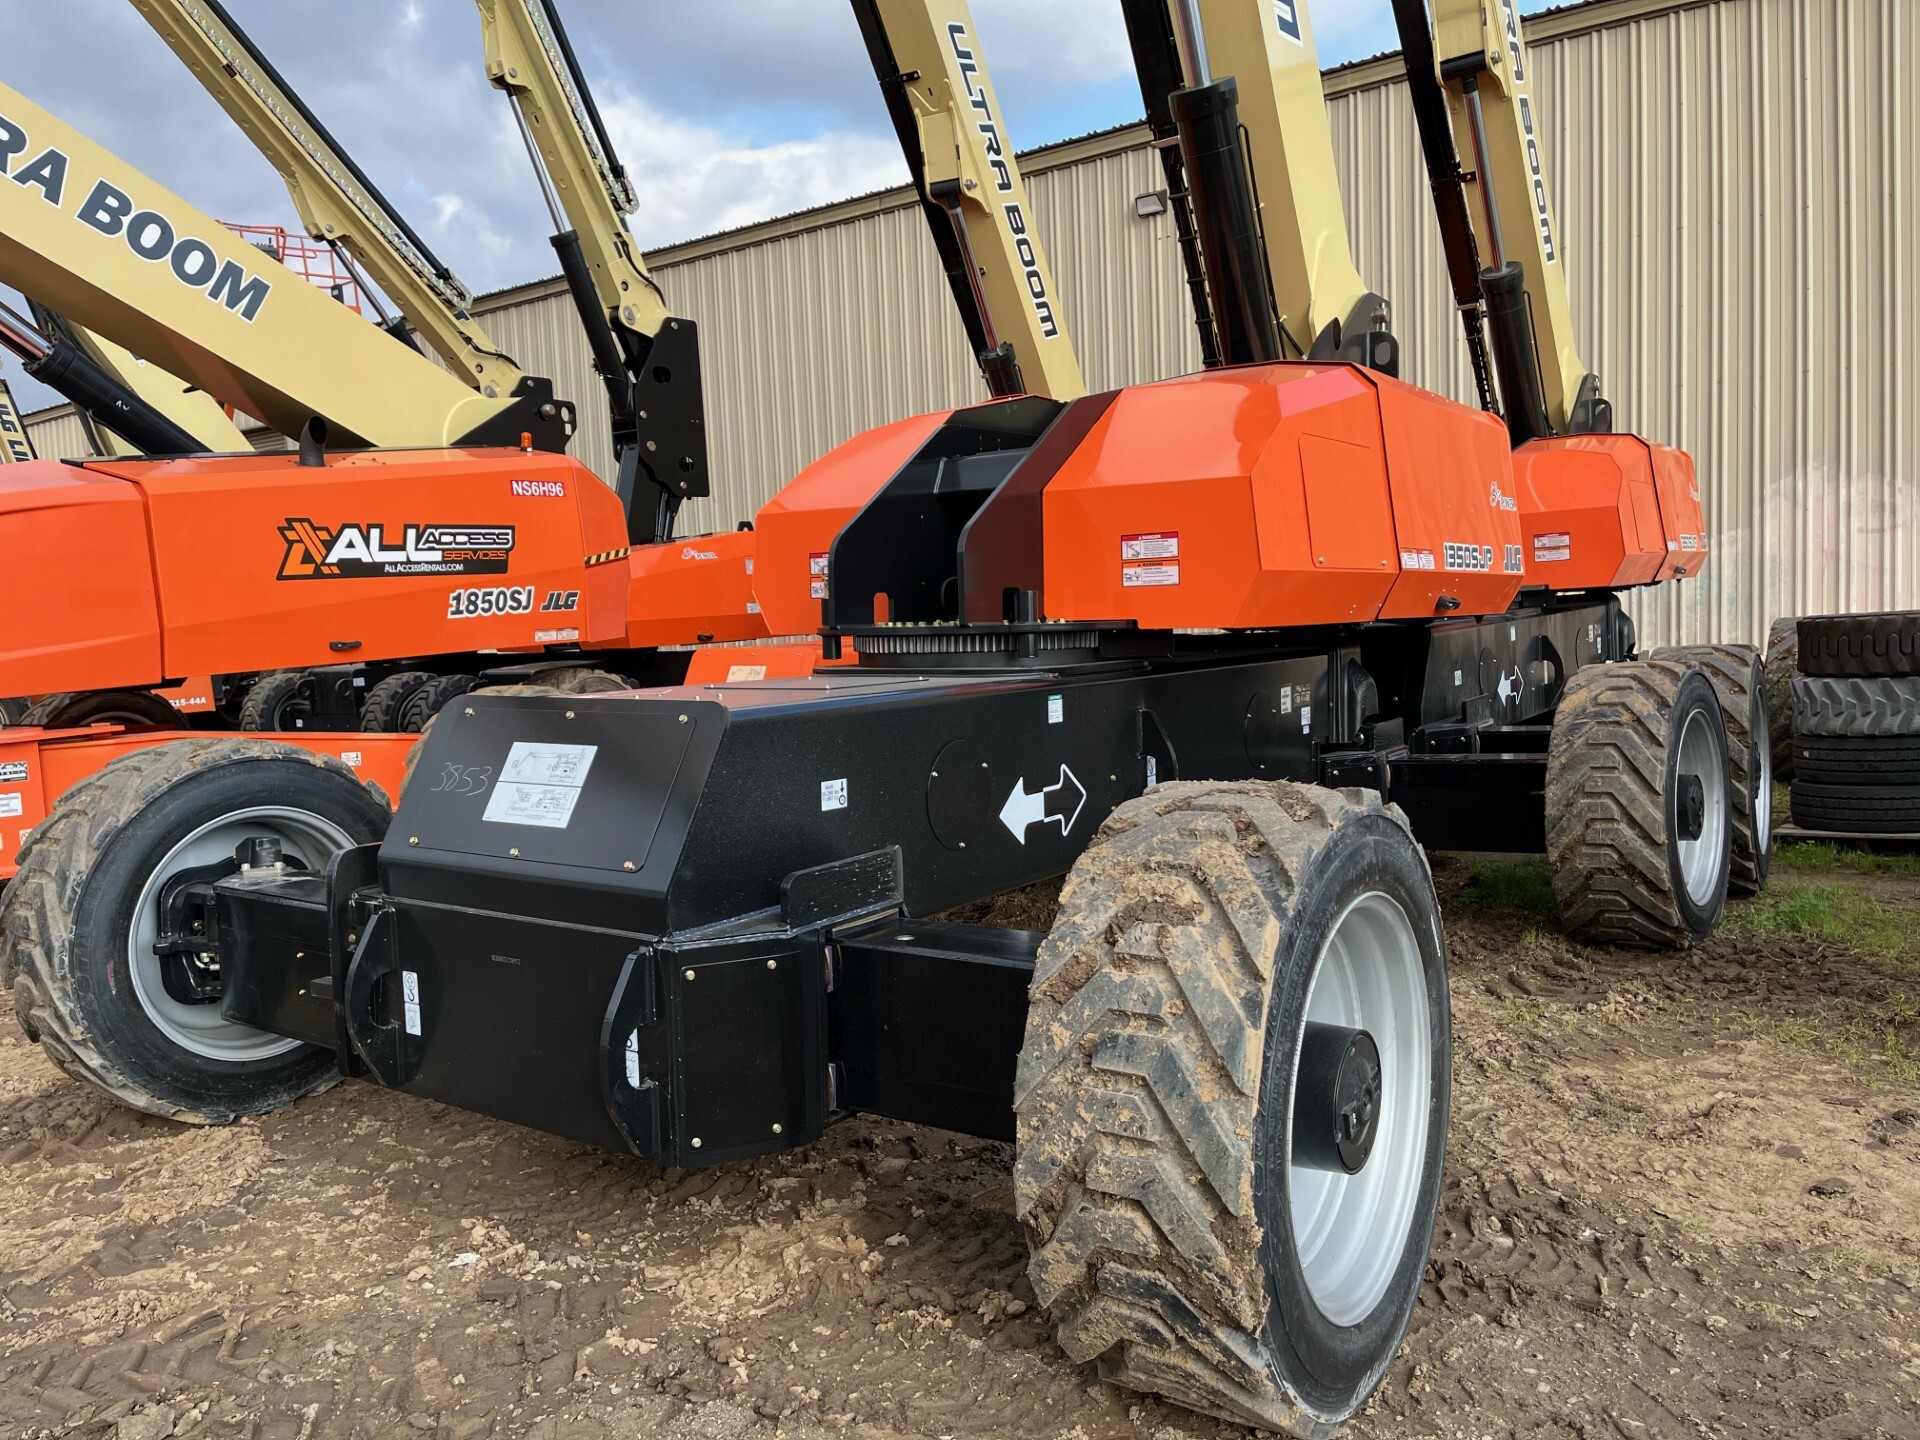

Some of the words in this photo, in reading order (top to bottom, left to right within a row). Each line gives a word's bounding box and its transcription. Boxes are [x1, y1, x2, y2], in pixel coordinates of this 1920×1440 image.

[947, 21, 1013, 193] ULTRA
[1003, 202, 1059, 339] BOOM
[1518, 94, 1556, 264] BOOM
[74, 177, 272, 325] BOOM
[512, 480, 564, 497] NS6H96
[324, 527, 443, 564] ALL
[418, 528, 513, 549] ACCESS
[443, 550, 507, 561] SERVICES
[1443, 542, 1493, 571] 1350SJP
[1504, 544, 1523, 573] JLG
[447, 586, 535, 619] 1850SJ
[540, 590, 580, 612] JLG
[429, 762, 493, 796] 3853
